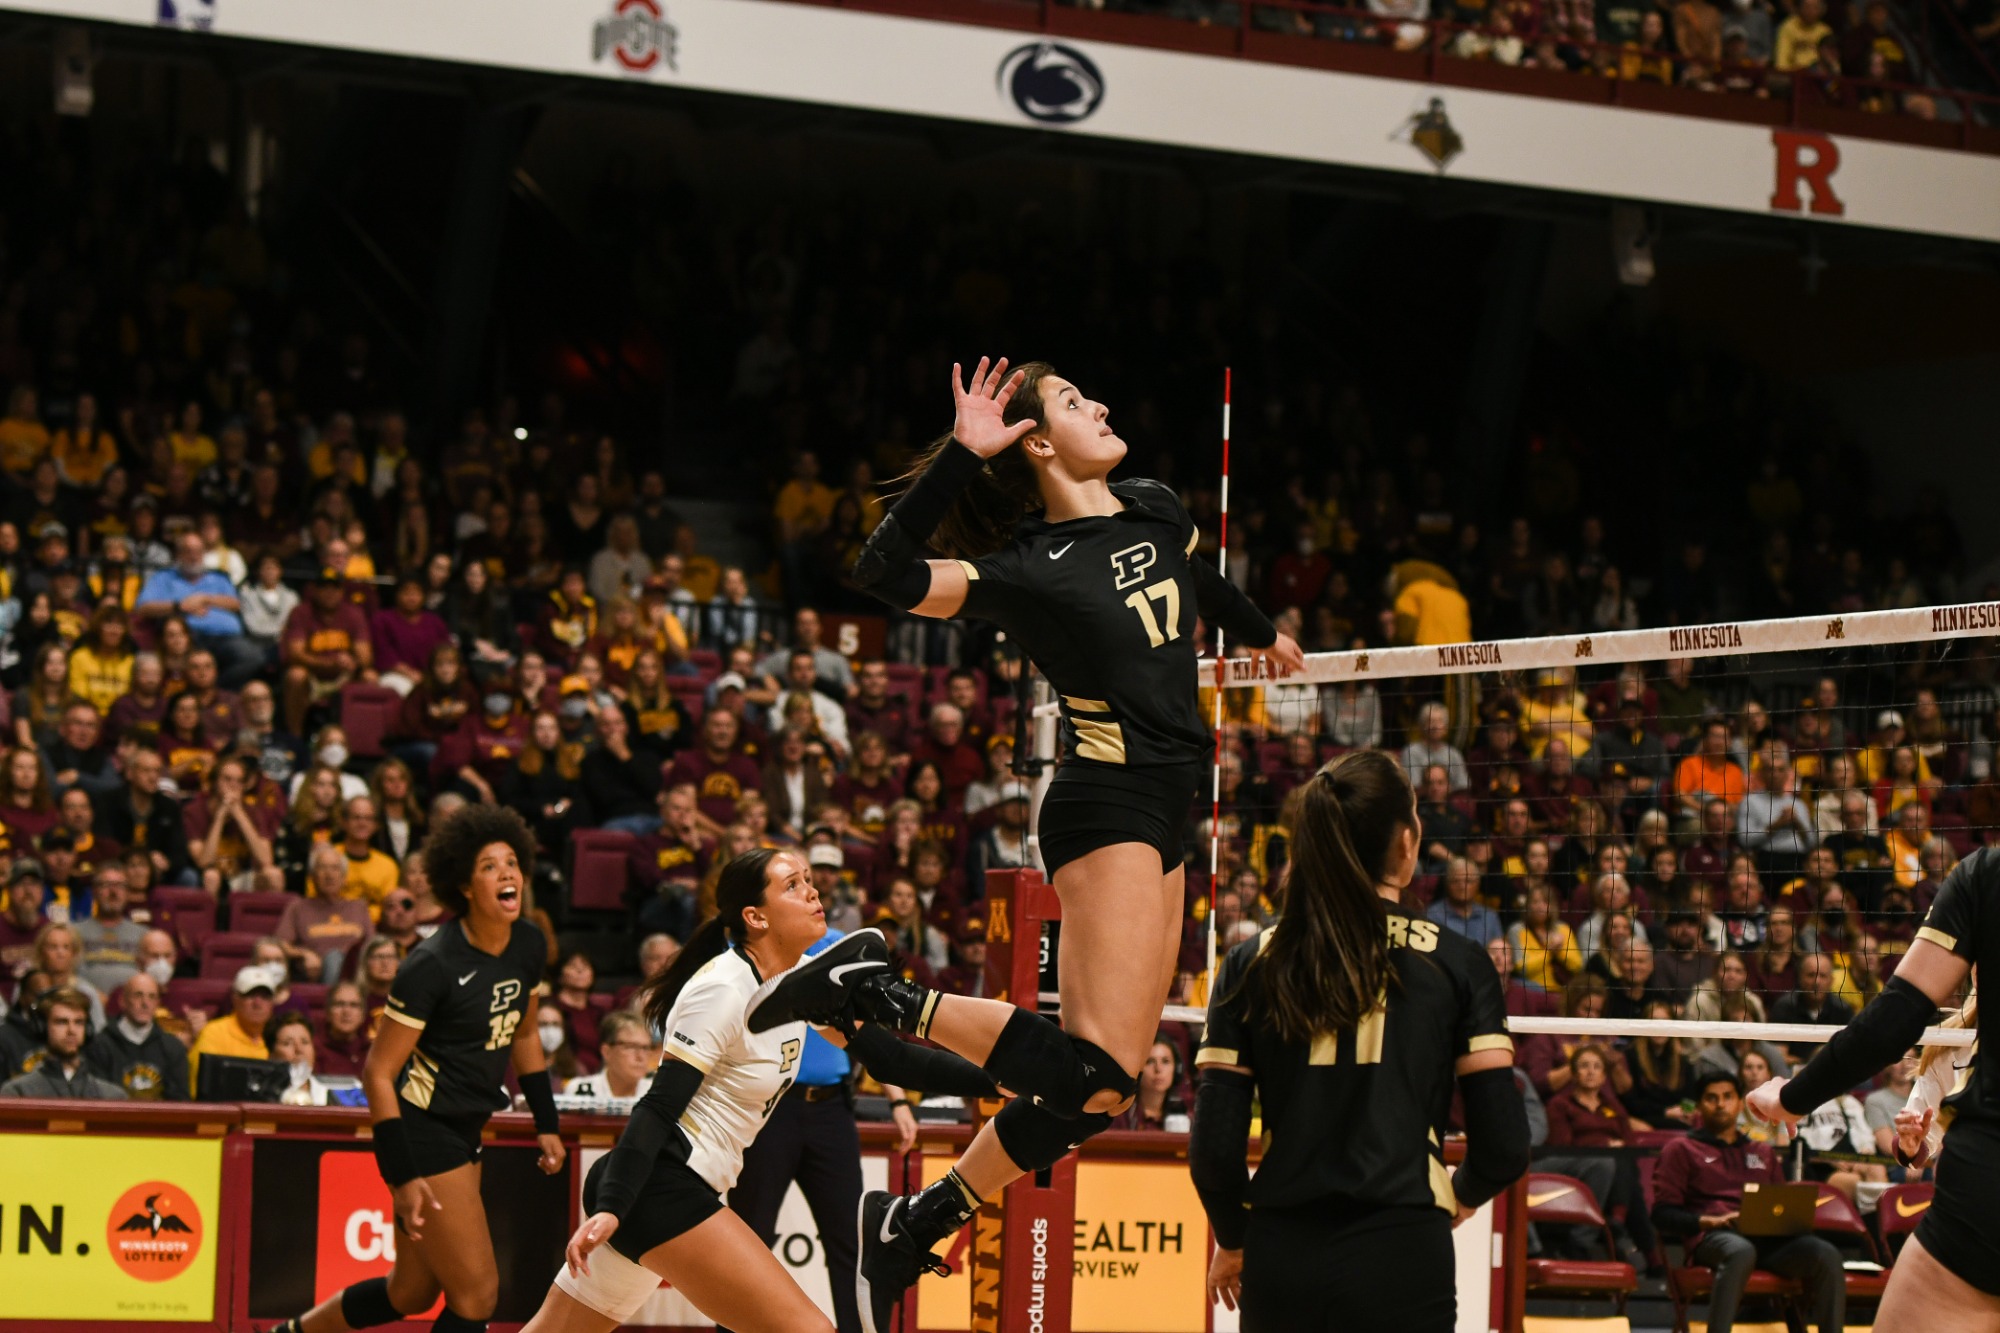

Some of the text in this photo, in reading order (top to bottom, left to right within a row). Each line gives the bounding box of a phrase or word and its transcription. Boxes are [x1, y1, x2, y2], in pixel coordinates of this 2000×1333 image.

[1770, 130, 1845, 217] R
[1110, 541, 1157, 591] P
[1124, 577, 1181, 649] 17
[1437, 643, 1502, 668] MINNESOTA
[1669, 624, 1742, 652] MINNESOTA
[489, 978, 521, 1013] P
[485, 1010, 521, 1050] 12
[779, 1038, 800, 1074] P
[119, 1240, 188, 1252] MINNESOTA
[125, 1252, 183, 1262] LOTTERY
[1031, 1218, 1049, 1281] sports
